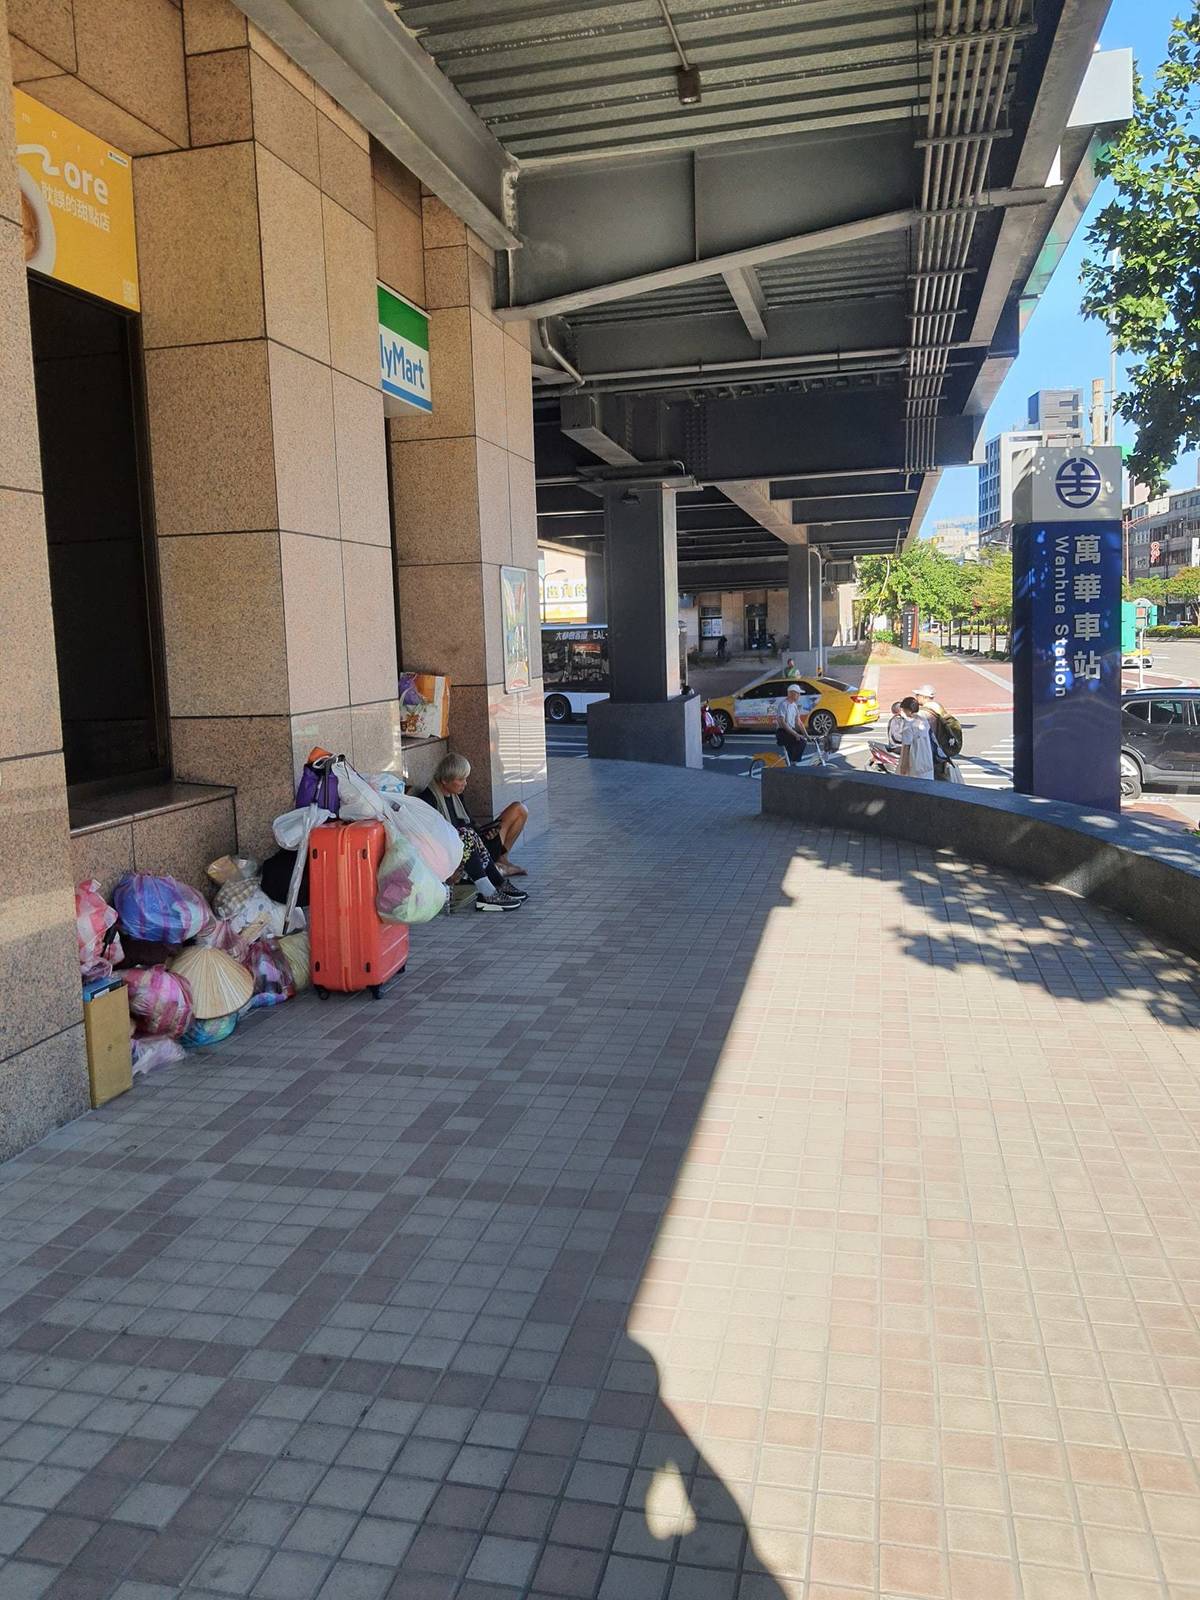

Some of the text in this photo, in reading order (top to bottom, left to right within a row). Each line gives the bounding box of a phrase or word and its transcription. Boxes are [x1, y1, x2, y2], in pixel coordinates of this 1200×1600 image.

[1055, 535, 1070, 697] Wanhua Station
[1073, 534, 1102, 680] 萬華車站
